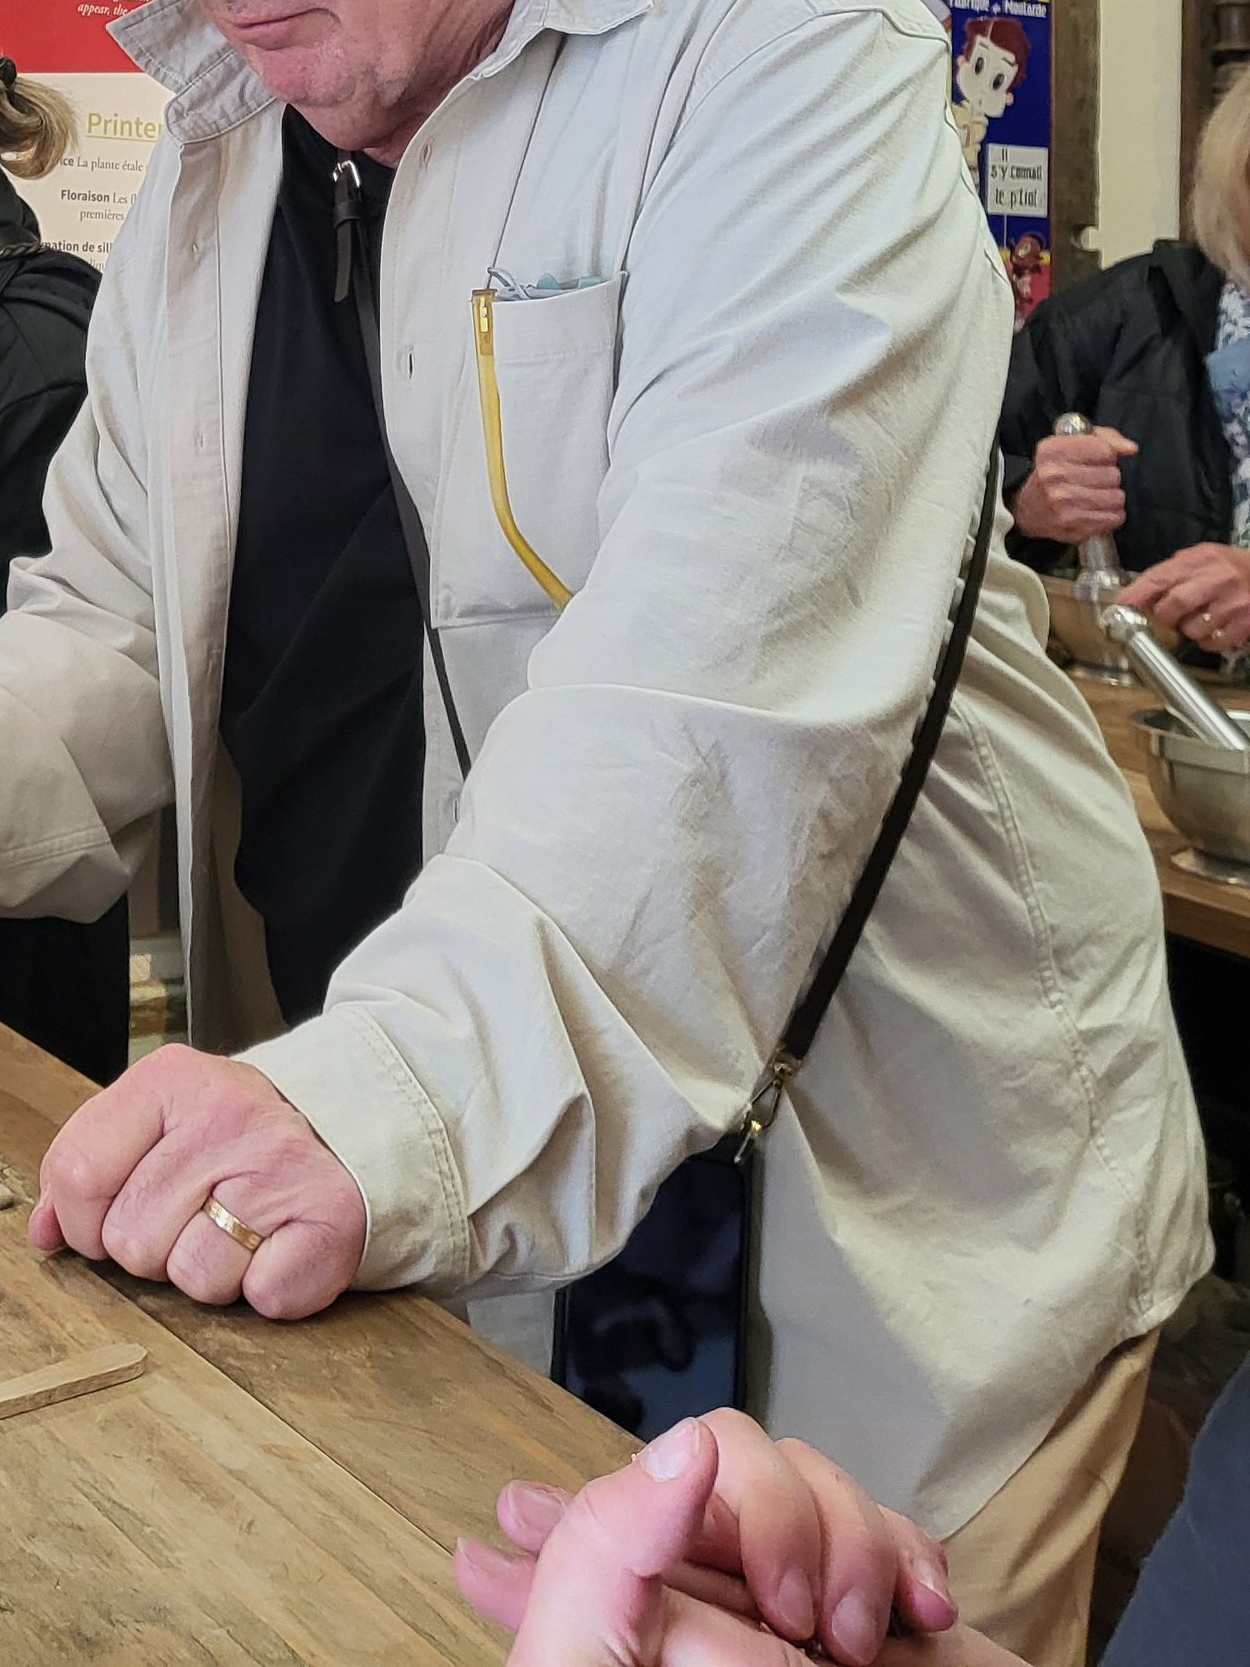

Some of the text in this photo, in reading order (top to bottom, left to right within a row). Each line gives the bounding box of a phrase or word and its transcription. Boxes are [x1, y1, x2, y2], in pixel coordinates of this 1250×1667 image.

[77, 2, 127, 17] appear, the
[77, 156, 88, 167] La
[91, 158, 120, 171] plante
[122, 159, 143, 171] étale
[61, 189, 110, 202] Floraison
[113, 192, 128, 203] Les
[79, 209, 125, 221] premières
[82, 241, 95, 252] de
